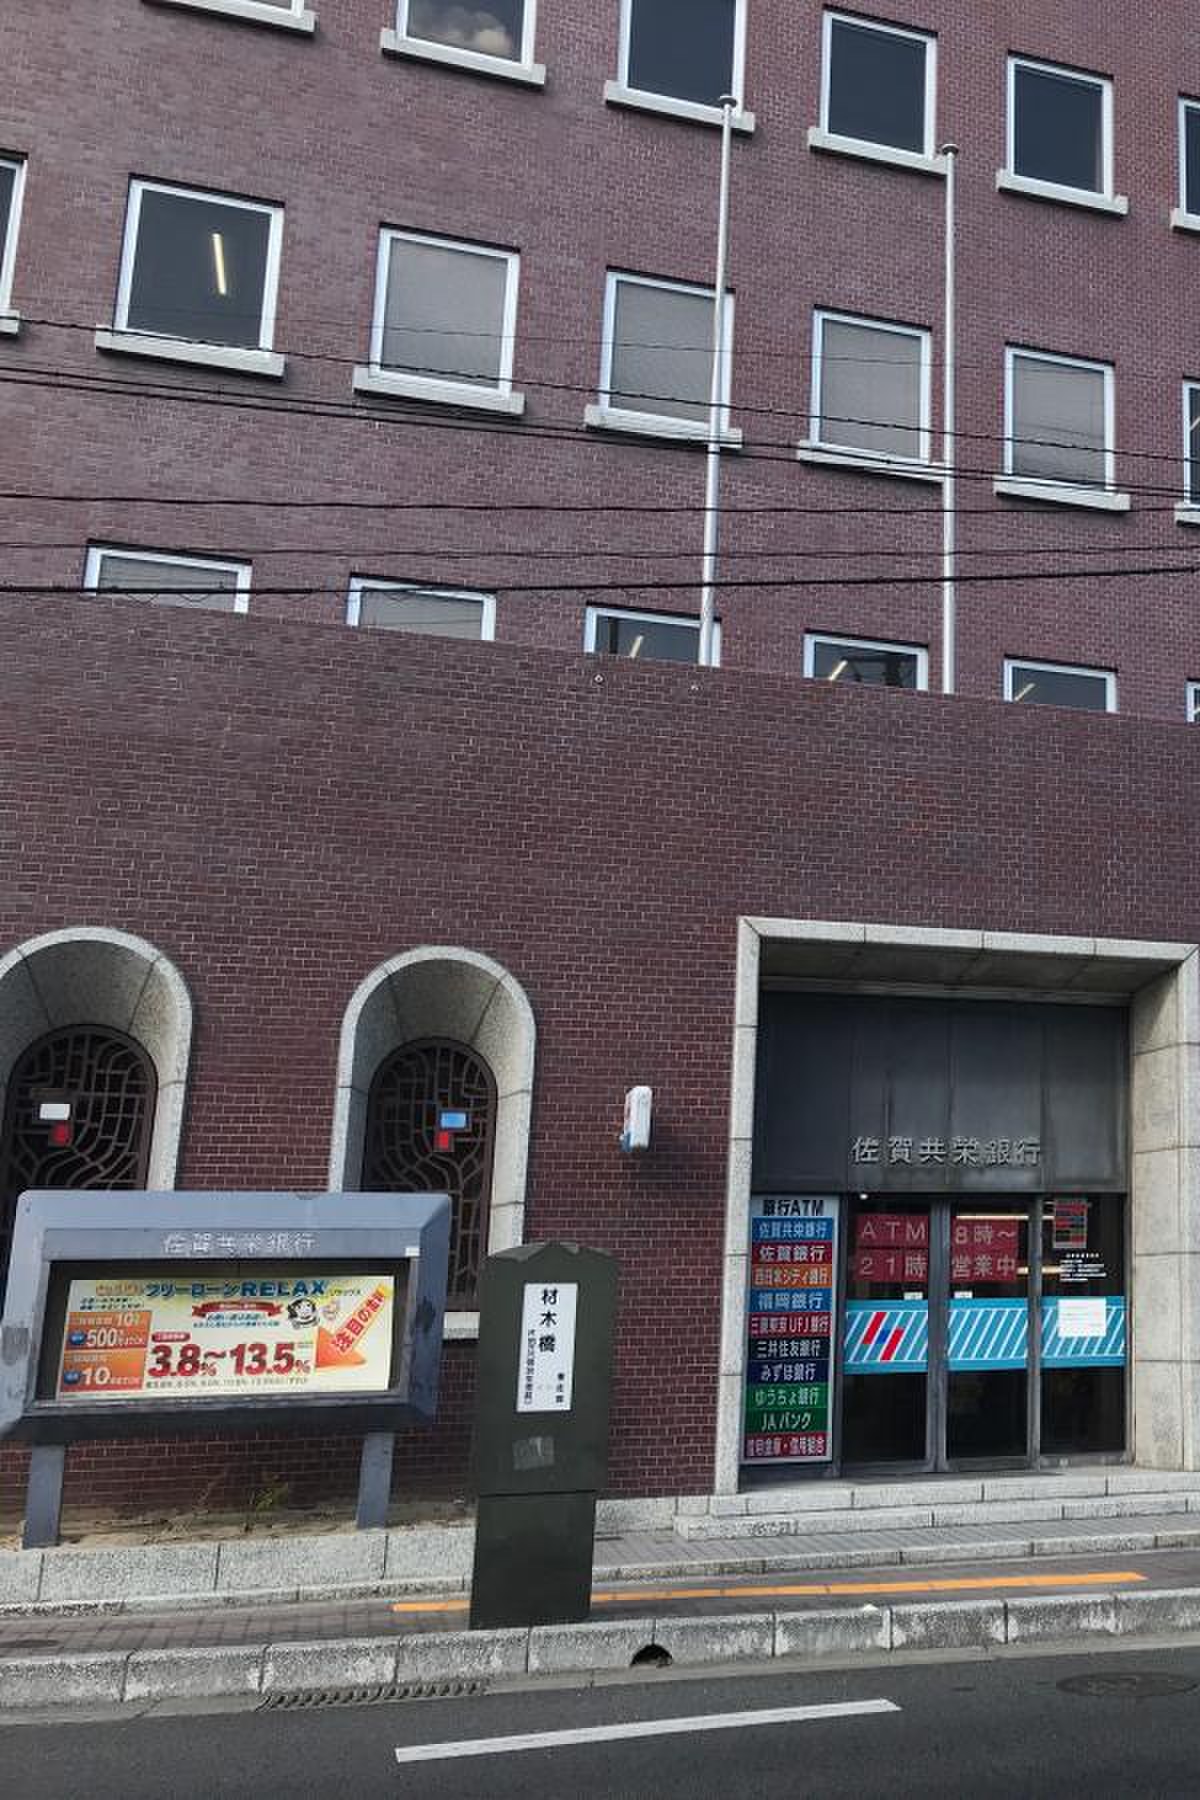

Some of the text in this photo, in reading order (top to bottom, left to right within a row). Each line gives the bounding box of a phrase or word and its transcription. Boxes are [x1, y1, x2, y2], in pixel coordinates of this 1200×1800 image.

[851, 1135, 1041, 1167] 佐賀共栄銀行
[861, 1221, 926, 1242] ATM
[160, 1231, 321, 1256] 佐賀共栄銀行
[760, 1244, 825, 1262] 佐賀銀行
[860, 1254, 1016, 1278] 21時 営業中
[758, 1292, 823, 1310] 福岡銀行
[539, 1288, 559, 1353] 材木橋
[757, 1339, 820, 1358] 三井住友銀行
[760, 1363, 816, 1381] みずほ銀行
[755, 1387, 820, 1406] ゆうちょ銀行
[761, 1411, 812, 1431] JAバンク
